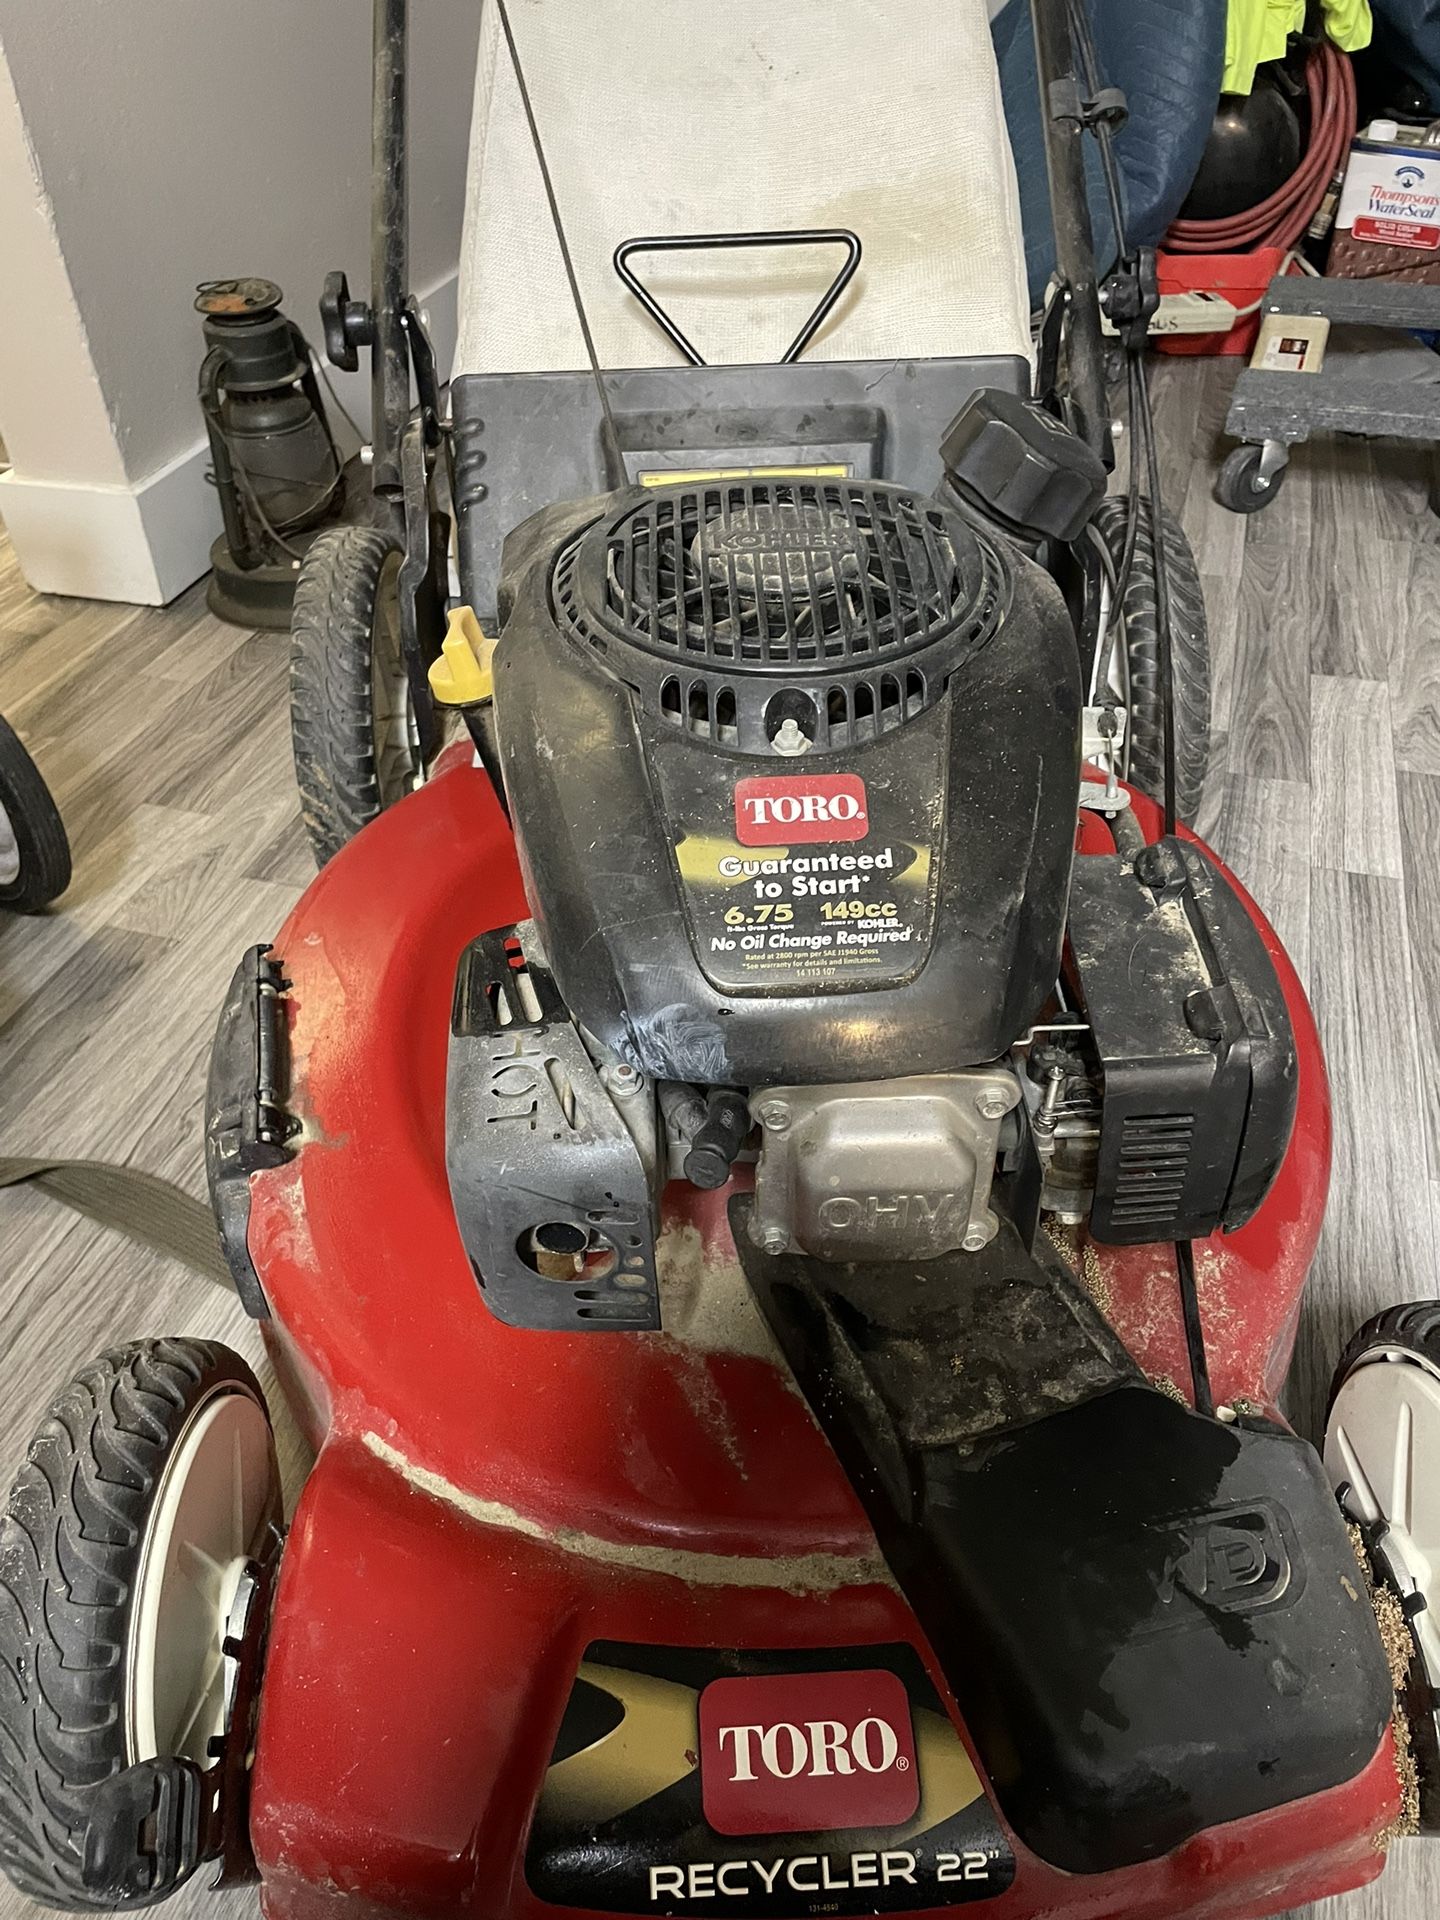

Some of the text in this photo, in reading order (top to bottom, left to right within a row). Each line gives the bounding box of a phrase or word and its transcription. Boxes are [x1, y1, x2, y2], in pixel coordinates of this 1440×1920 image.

[1369, 199, 1437, 218] WaterSeal
[744, 794, 858, 824] TORO
[718, 847, 893, 876] Guaranteed
[753, 880, 783, 898] to
[724, 901, 898, 925] 6.75 149cc
[711, 926, 911, 951] No Oil Change Required
[769, 923, 794, 931] Torque
[745, 953, 765, 961] Rated
[760, 961, 791, 969] warranty
[804, 958, 828, 967] details
[796, 967, 836, 977] 14 113 107
[818, 1194, 955, 1232] OHV
[719, 1716, 898, 1782] TORO
[650, 1851, 918, 1900] RECYCLER
